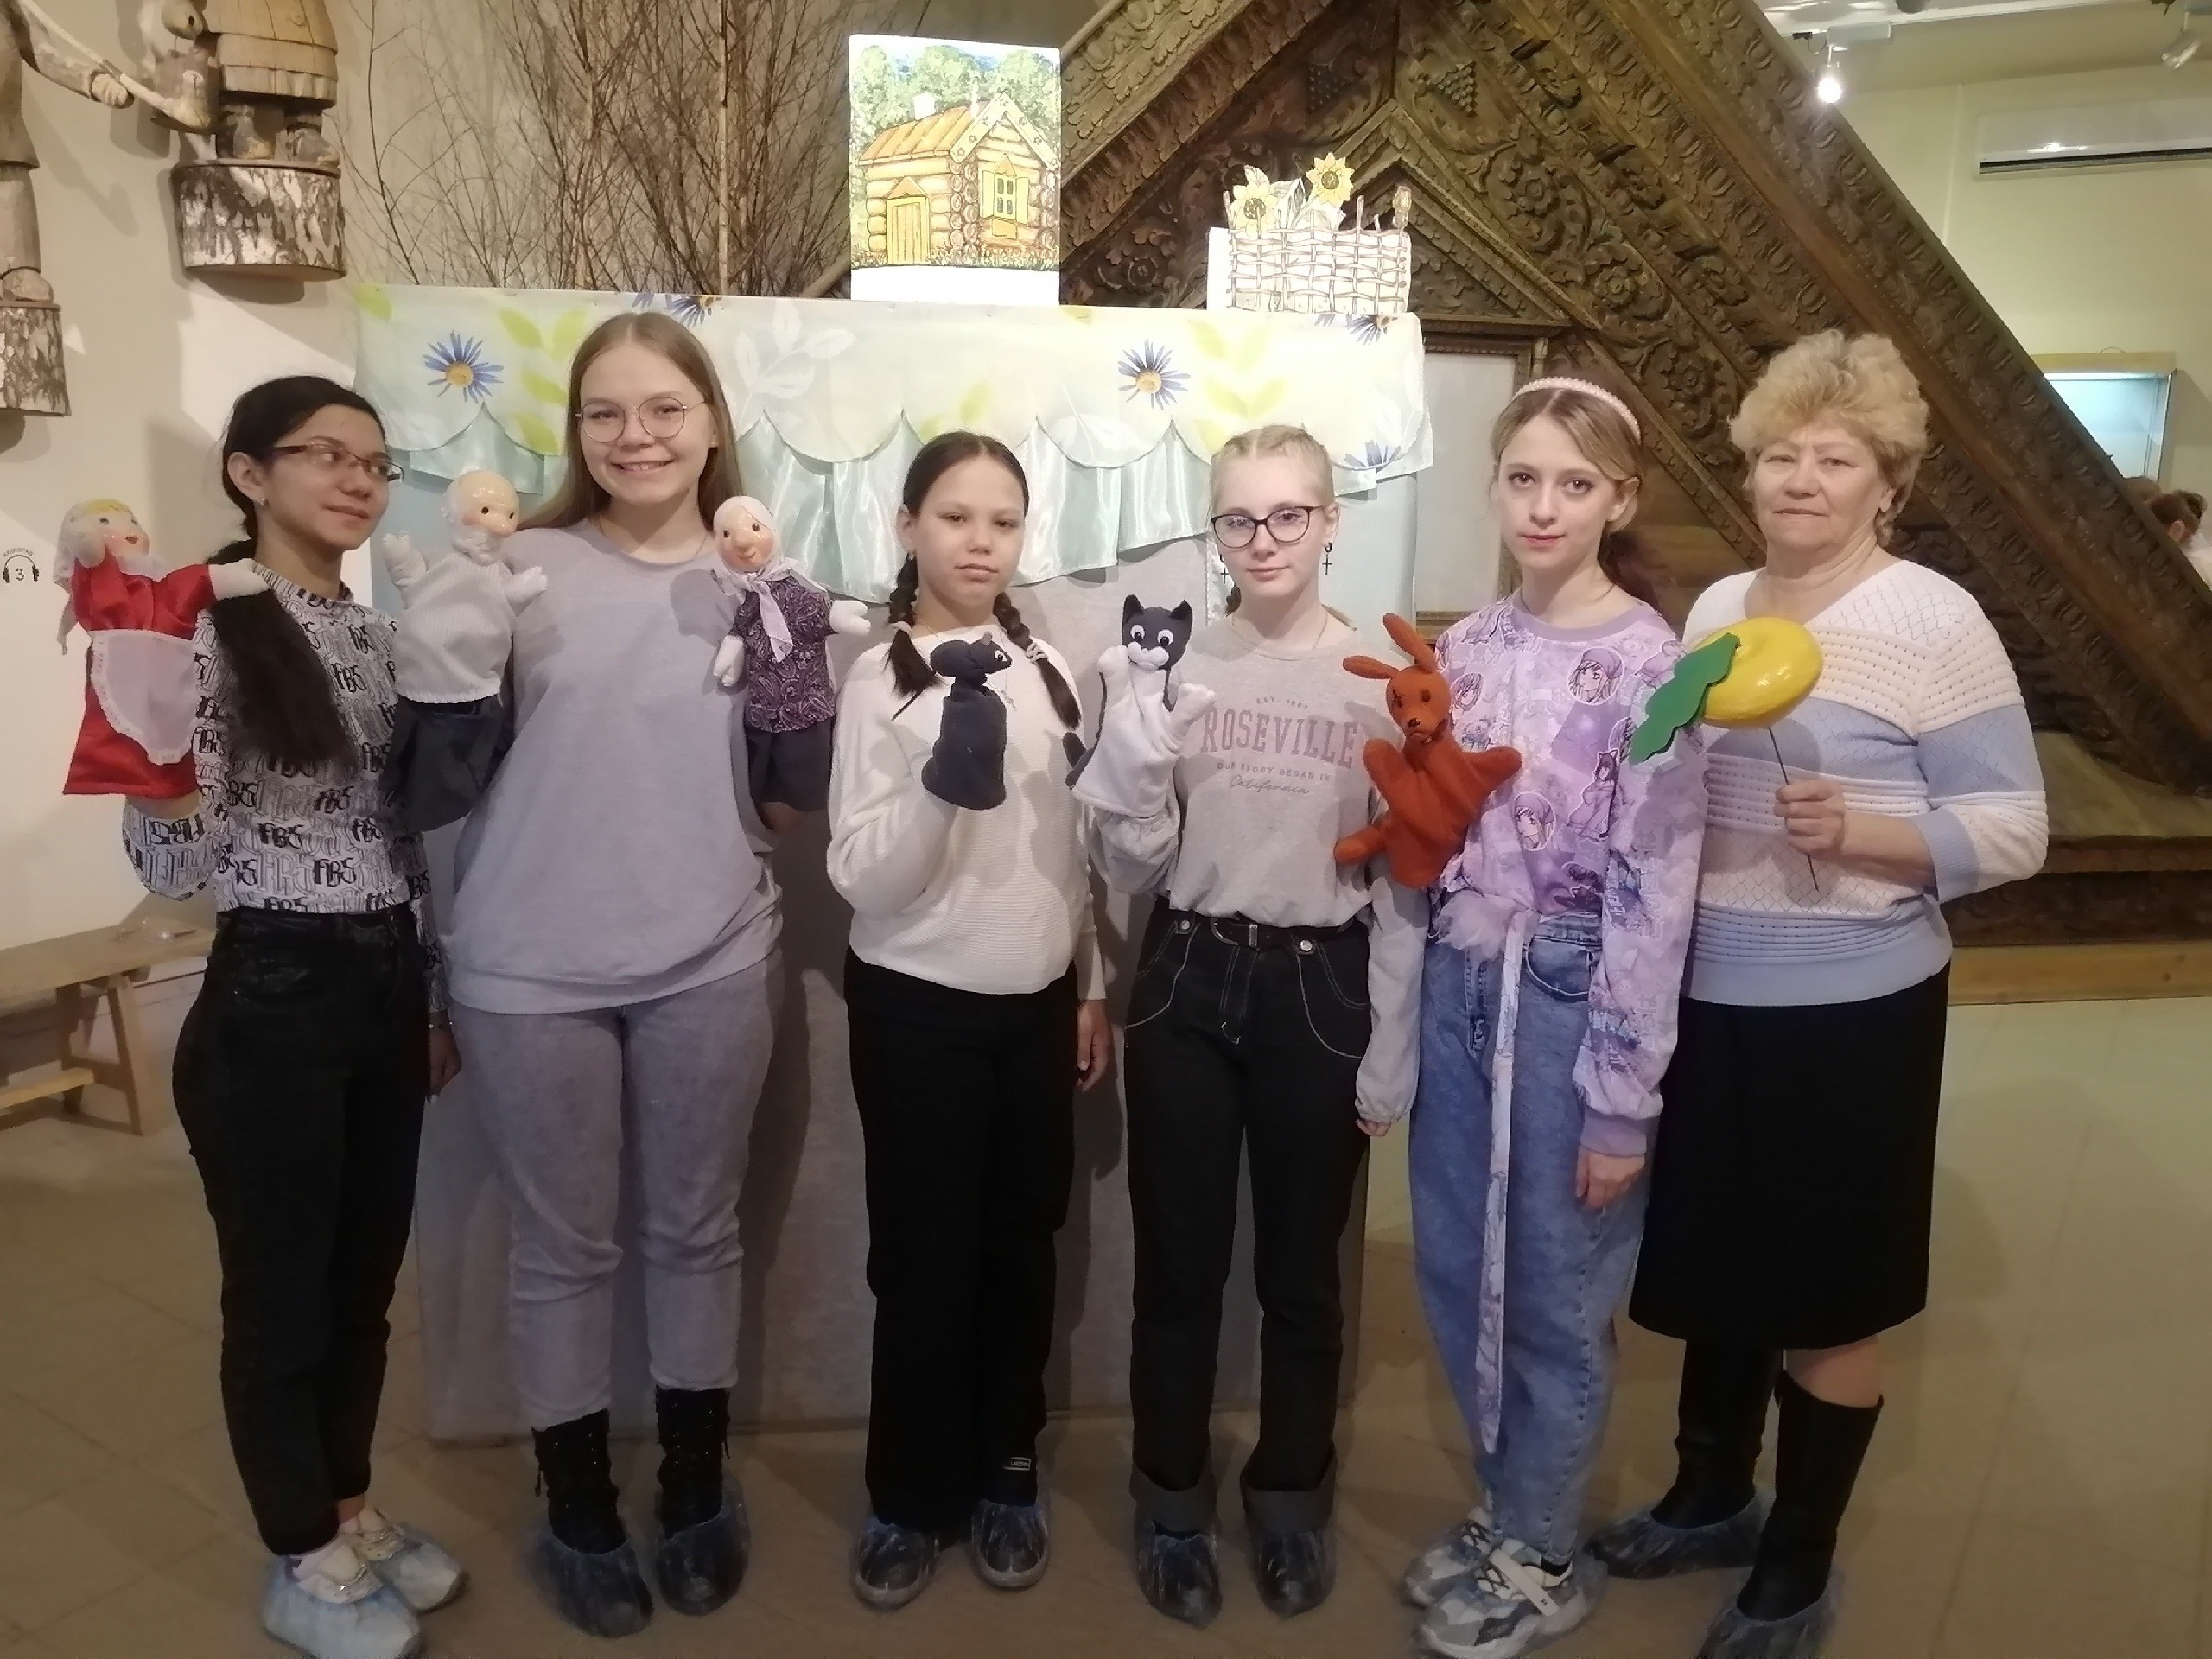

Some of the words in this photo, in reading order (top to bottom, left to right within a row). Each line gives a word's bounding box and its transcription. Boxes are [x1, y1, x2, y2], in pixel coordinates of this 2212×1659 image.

[16, 568, 25, 581] 3
[1200, 705, 1358, 769] ROSEVILLE
[1241, 763, 1274, 774] STORY
[1279, 768, 1315, 779] BEGAN
[1319, 773, 1332, 782] IN
